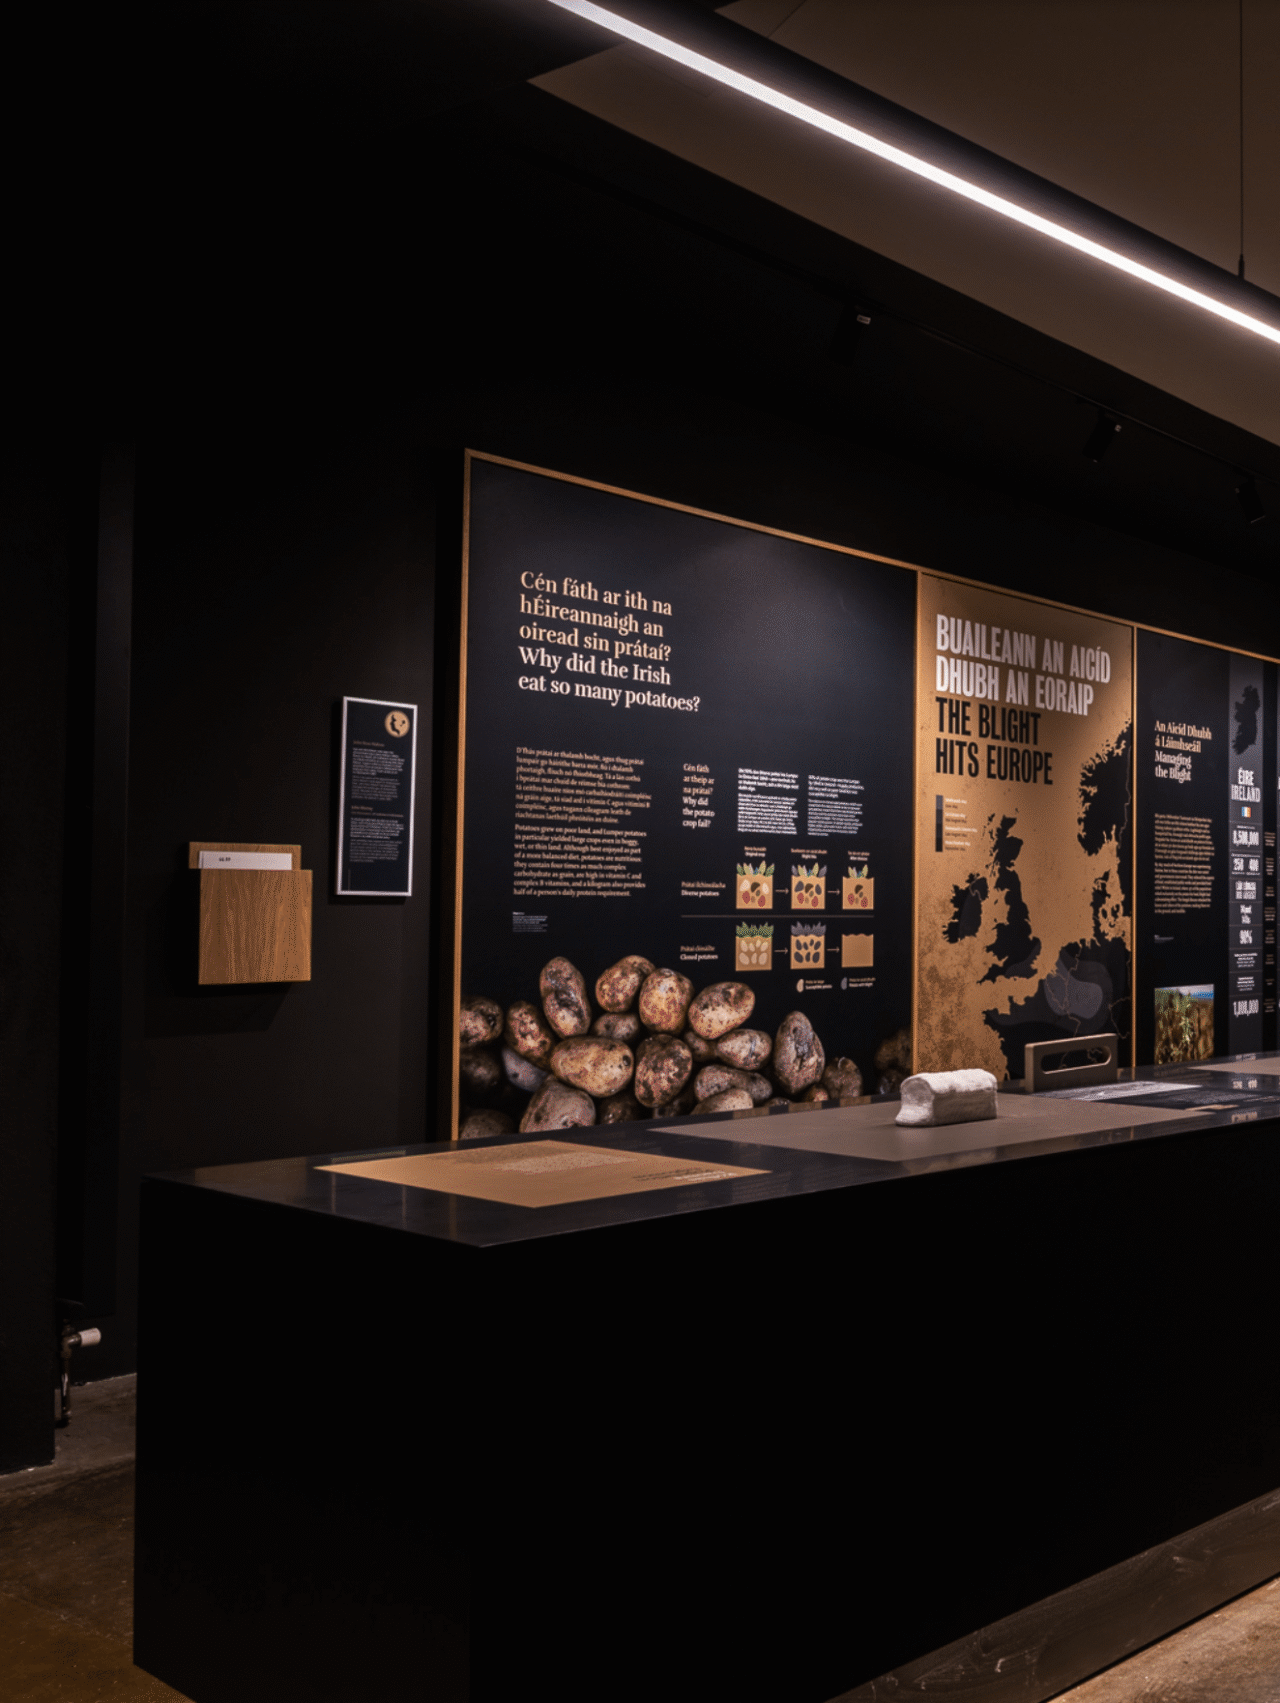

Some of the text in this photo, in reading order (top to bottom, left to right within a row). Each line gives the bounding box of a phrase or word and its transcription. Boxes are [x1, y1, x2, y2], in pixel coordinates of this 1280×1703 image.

[521, 571, 672, 616] Cén fáth ar ith na
[520, 594, 663, 637] hÉireannaigh an
[519, 622, 671, 661] oiread sin prátaí?
[937, 614, 1111, 684] BUAILEANN AN AICÍD
[519, 646, 671, 685] Why did the Irish
[519, 676, 701, 712] eat so many potatoes?
[936, 655, 1093, 716] DHUBH AN EORAIP
[936, 697, 1041, 745] THE BLIGHT
[1155, 720, 1212, 740] An Aicíd Dhubh
[1155, 734, 1201, 753] á Láimhseáil
[683, 764, 709, 773] Cén fáth
[936, 738, 1053, 785] HITS EUROPE
[1155, 750, 1192, 769] Managing
[691, 775, 707, 785] theip
[1155, 765, 1191, 783] the Blight
[691, 786, 713, 795] prátaí?
[1231, 784, 1260, 802] IRELAND
[683, 797, 708, 807] Why did
[683, 808, 715, 818] the potato
[683, 819, 711, 828] crop fail?
[698, 954, 718, 962] potatoes
